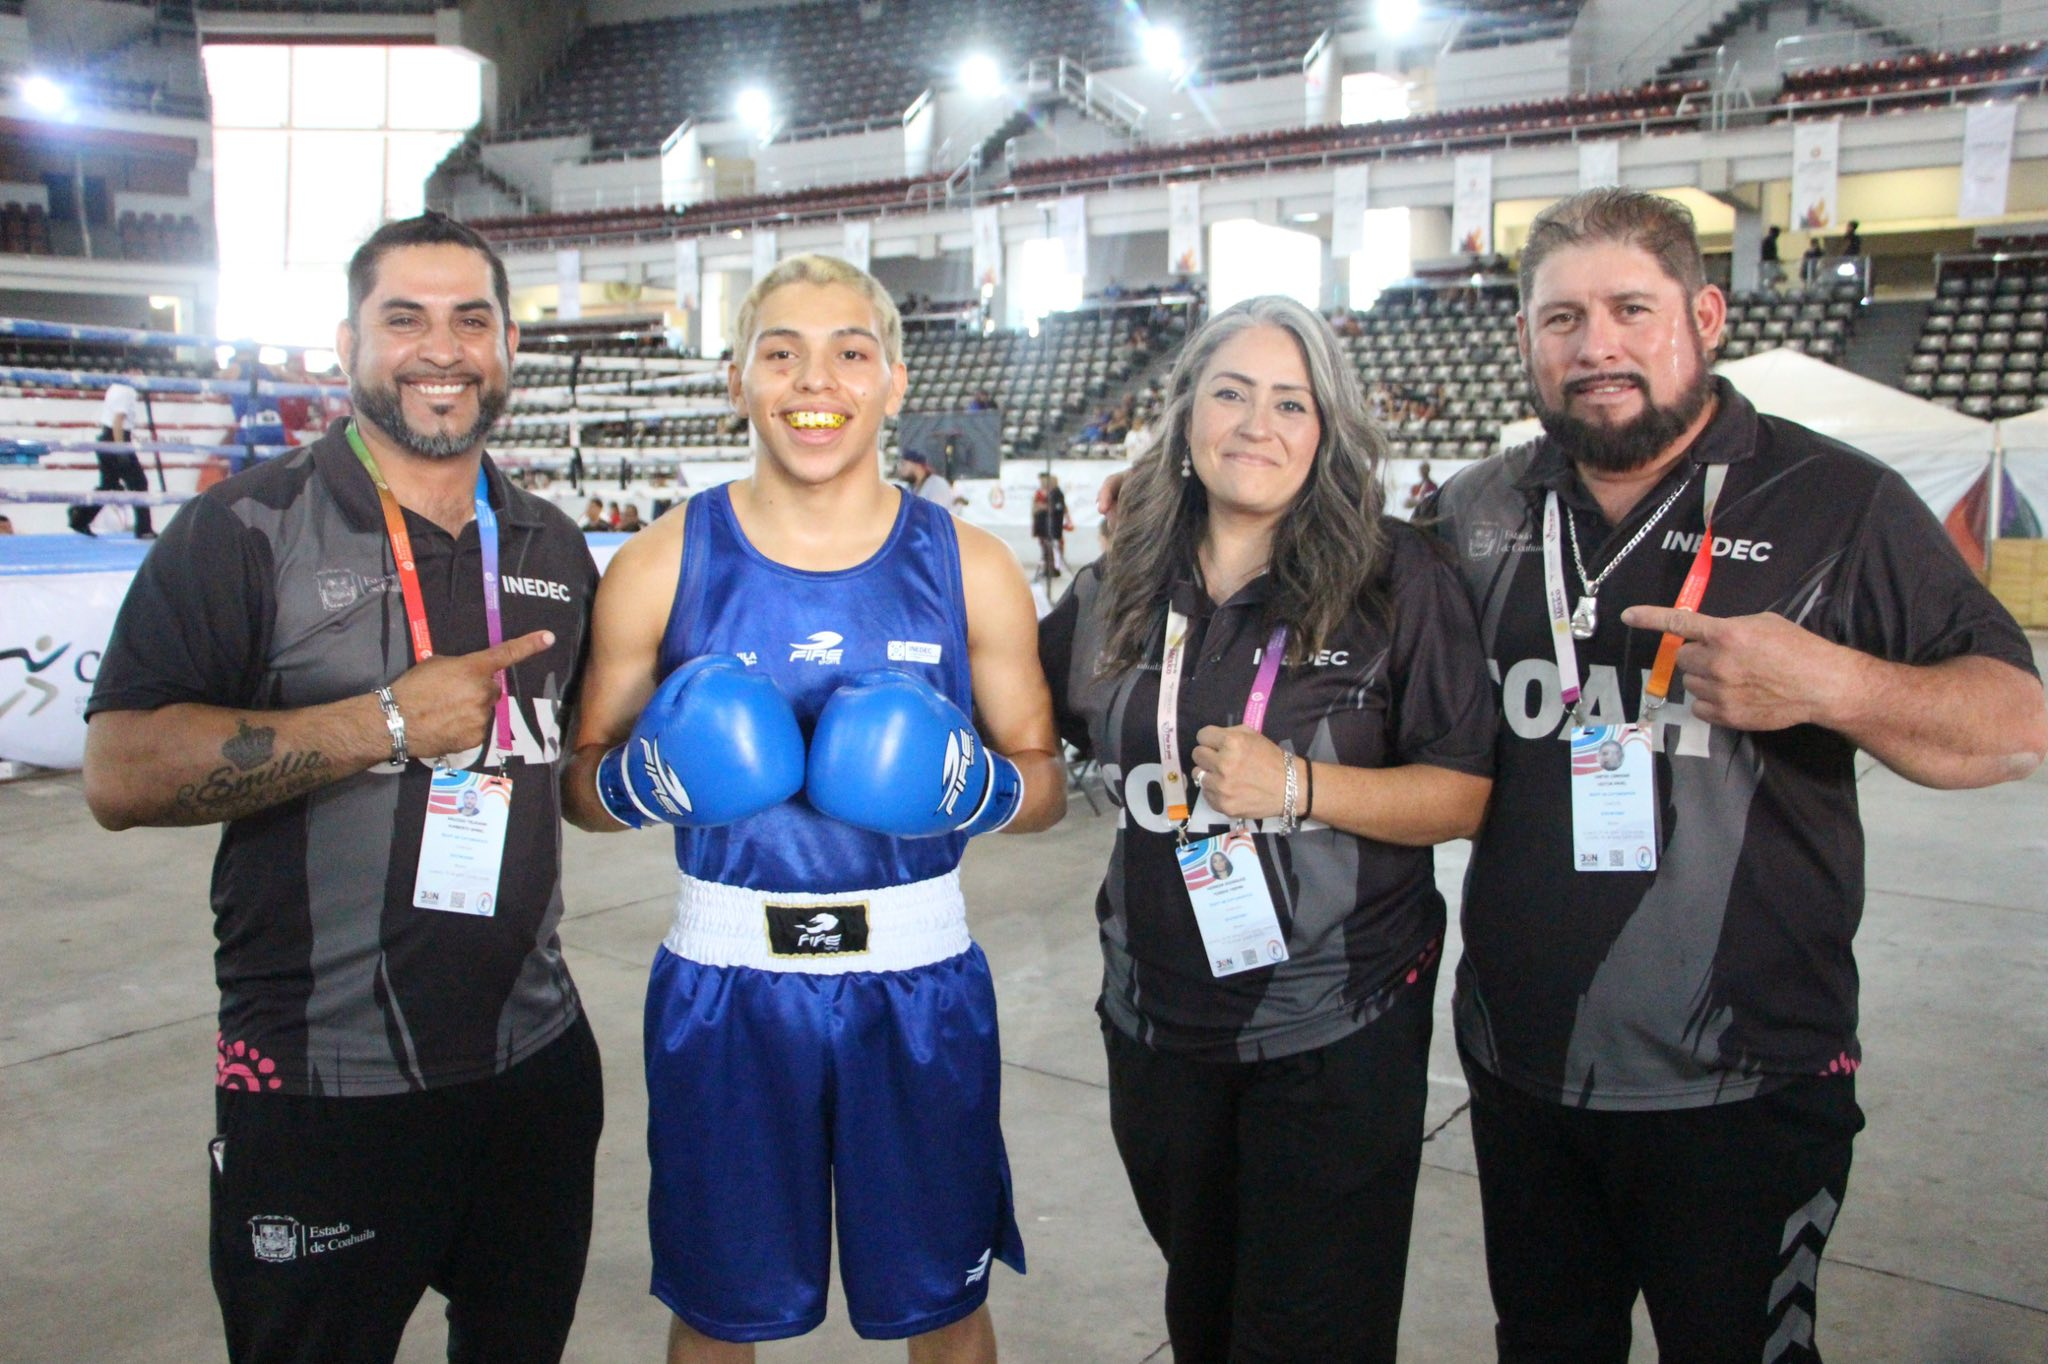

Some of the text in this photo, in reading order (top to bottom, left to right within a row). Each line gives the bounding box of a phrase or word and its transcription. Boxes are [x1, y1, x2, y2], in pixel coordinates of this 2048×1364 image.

[502, 575, 571, 602] INEDEC
[1252, 647, 1350, 667] IEC
[1487, 659, 1711, 758] OAH
[309, 1222, 351, 1239] Estado
[309, 1229, 376, 1254] de Coahuila
